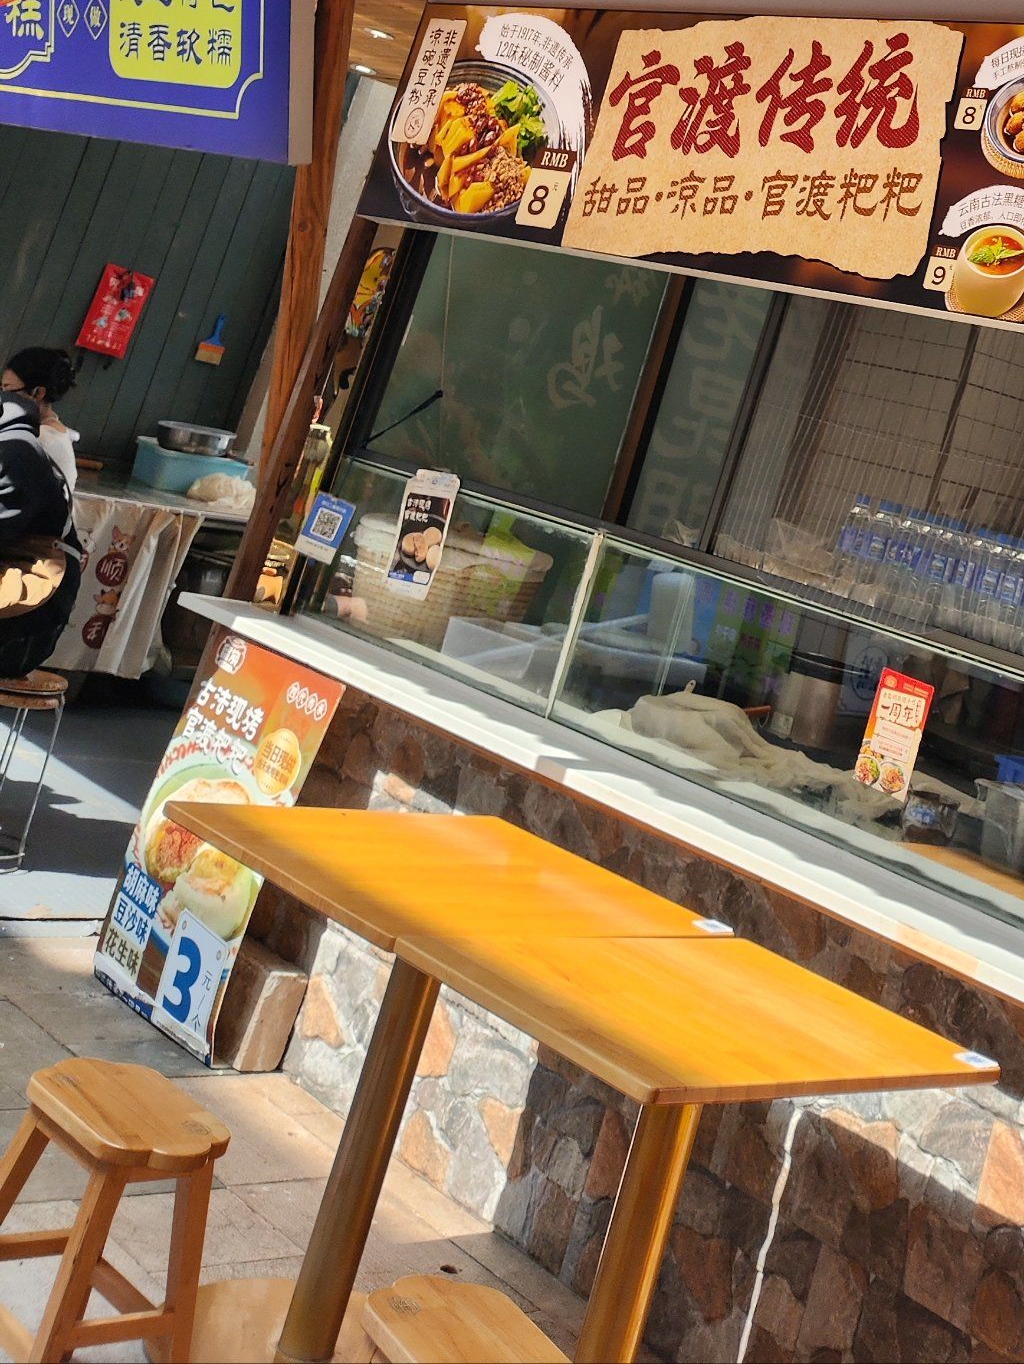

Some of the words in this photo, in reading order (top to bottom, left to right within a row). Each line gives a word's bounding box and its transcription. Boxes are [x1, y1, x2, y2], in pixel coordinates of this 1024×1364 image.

[118, 21, 234, 67] 清香软糯
[496, 41, 565, 93] 12味秘制酱料
[423, 29, 458, 108] 非遗传承
[607, 32, 921, 162] 官渡传统
[962, 106, 977, 125] 8
[965, 88, 986, 99] RMB
[541, 151, 570, 168] RMB
[527, 185, 550, 216] 8
[930, 265, 947, 286] 9
[935, 246, 957, 259] RMB
[196, 675, 265, 741] 古法现烤
[122, 867, 163, 915] 胡麻味
[113, 898, 150, 945] 豆沙味
[104, 927, 141, 978] 花生味
[161, 936, 202, 1024] 3
